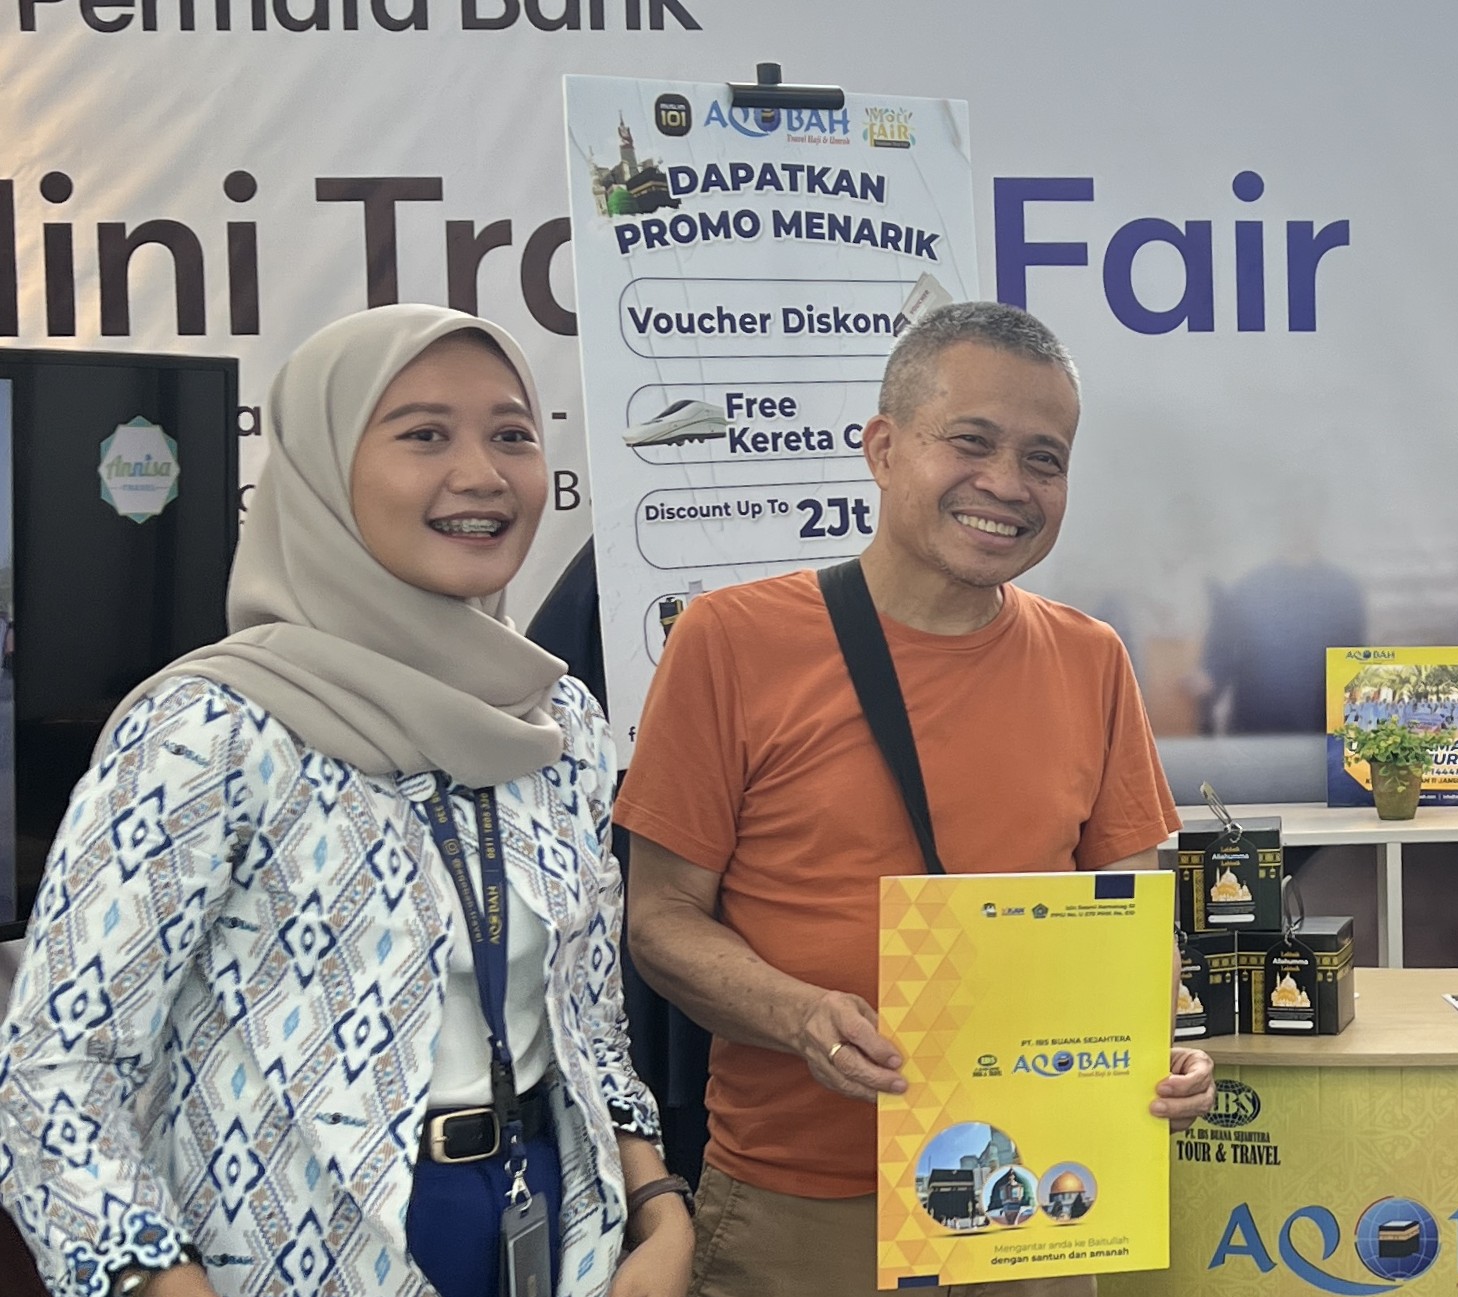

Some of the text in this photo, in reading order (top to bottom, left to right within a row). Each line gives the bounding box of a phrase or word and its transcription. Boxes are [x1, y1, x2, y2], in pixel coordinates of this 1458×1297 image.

[668, 162, 886, 204] DAPATKAN
[615, 208, 941, 262] PROMO MENARIK
[0, 170, 260, 337] ini
[993, 170, 1350, 336] Fair
[627, 304, 892, 336] Voucher Diskon
[726, 391, 797, 419] Free
[730, 422, 864, 454] Kereta C
[645, 496, 874, 538] Discount Up To 2Jt
[1012, 1049, 1131, 1078] AQOBAH
[1176, 1139, 1281, 1166] TOUR & TRAVEL
[990, 1247, 1129, 1266] dengan santun dan amanah
[993, 1235, 1129, 1254] Mengantar anda ke Baitullah
